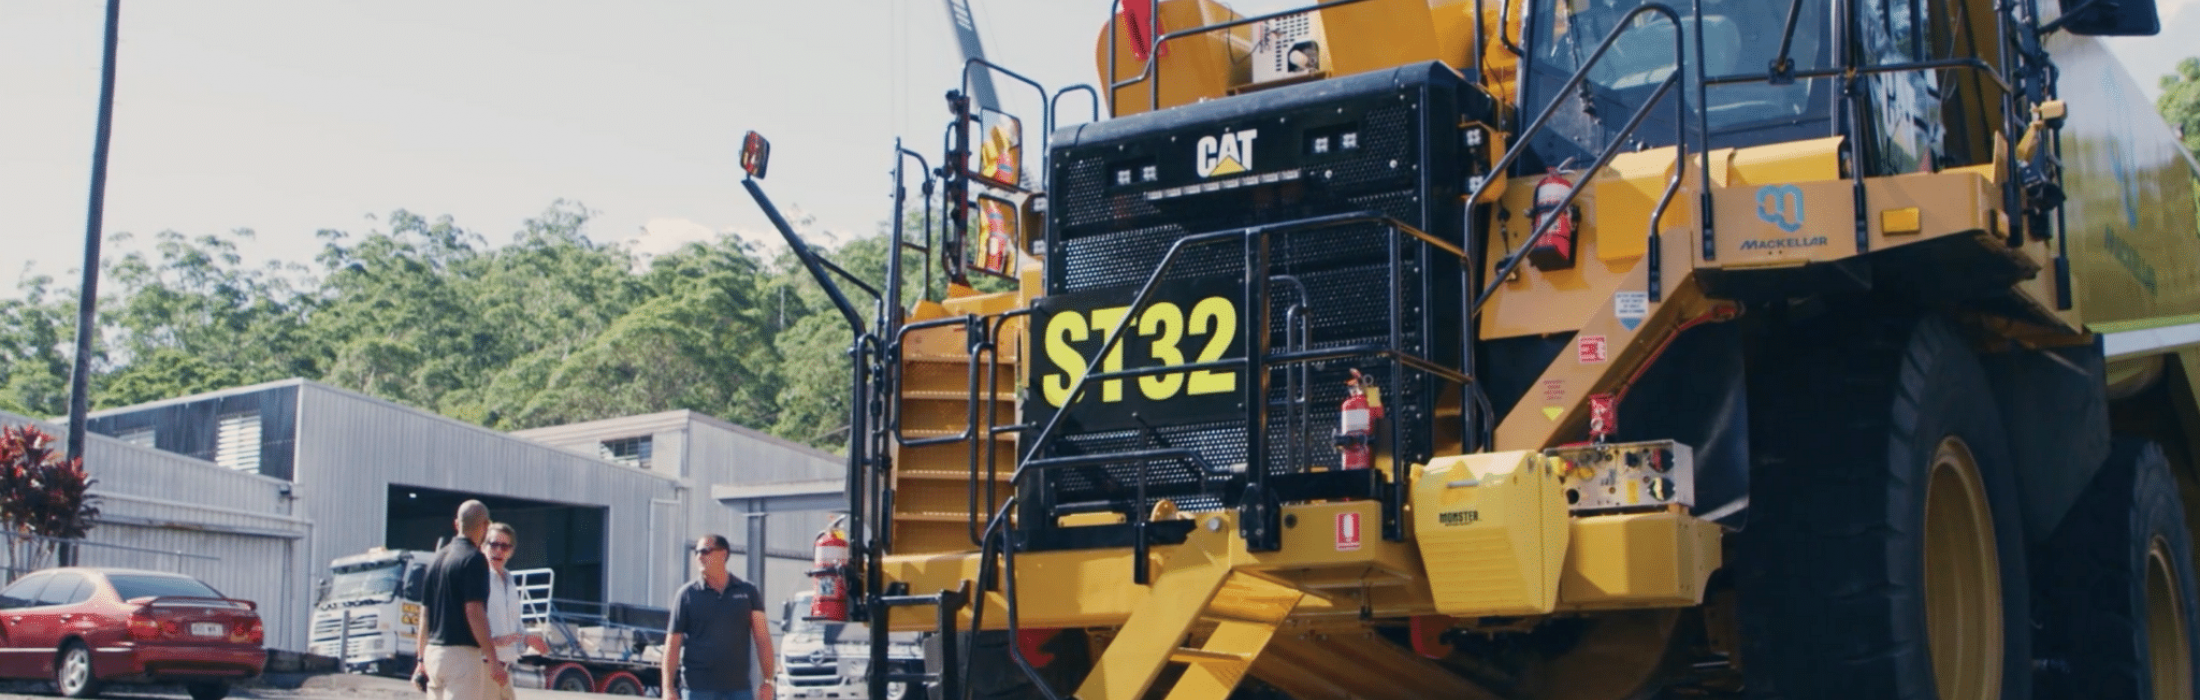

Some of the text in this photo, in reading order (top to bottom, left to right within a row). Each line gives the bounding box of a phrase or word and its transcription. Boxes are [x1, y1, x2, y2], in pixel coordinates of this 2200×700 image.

[1197, 128, 1257, 178] CAT
[1740, 236, 1828, 250] MACKELLAR
[1043, 296, 1237, 409] ST32
